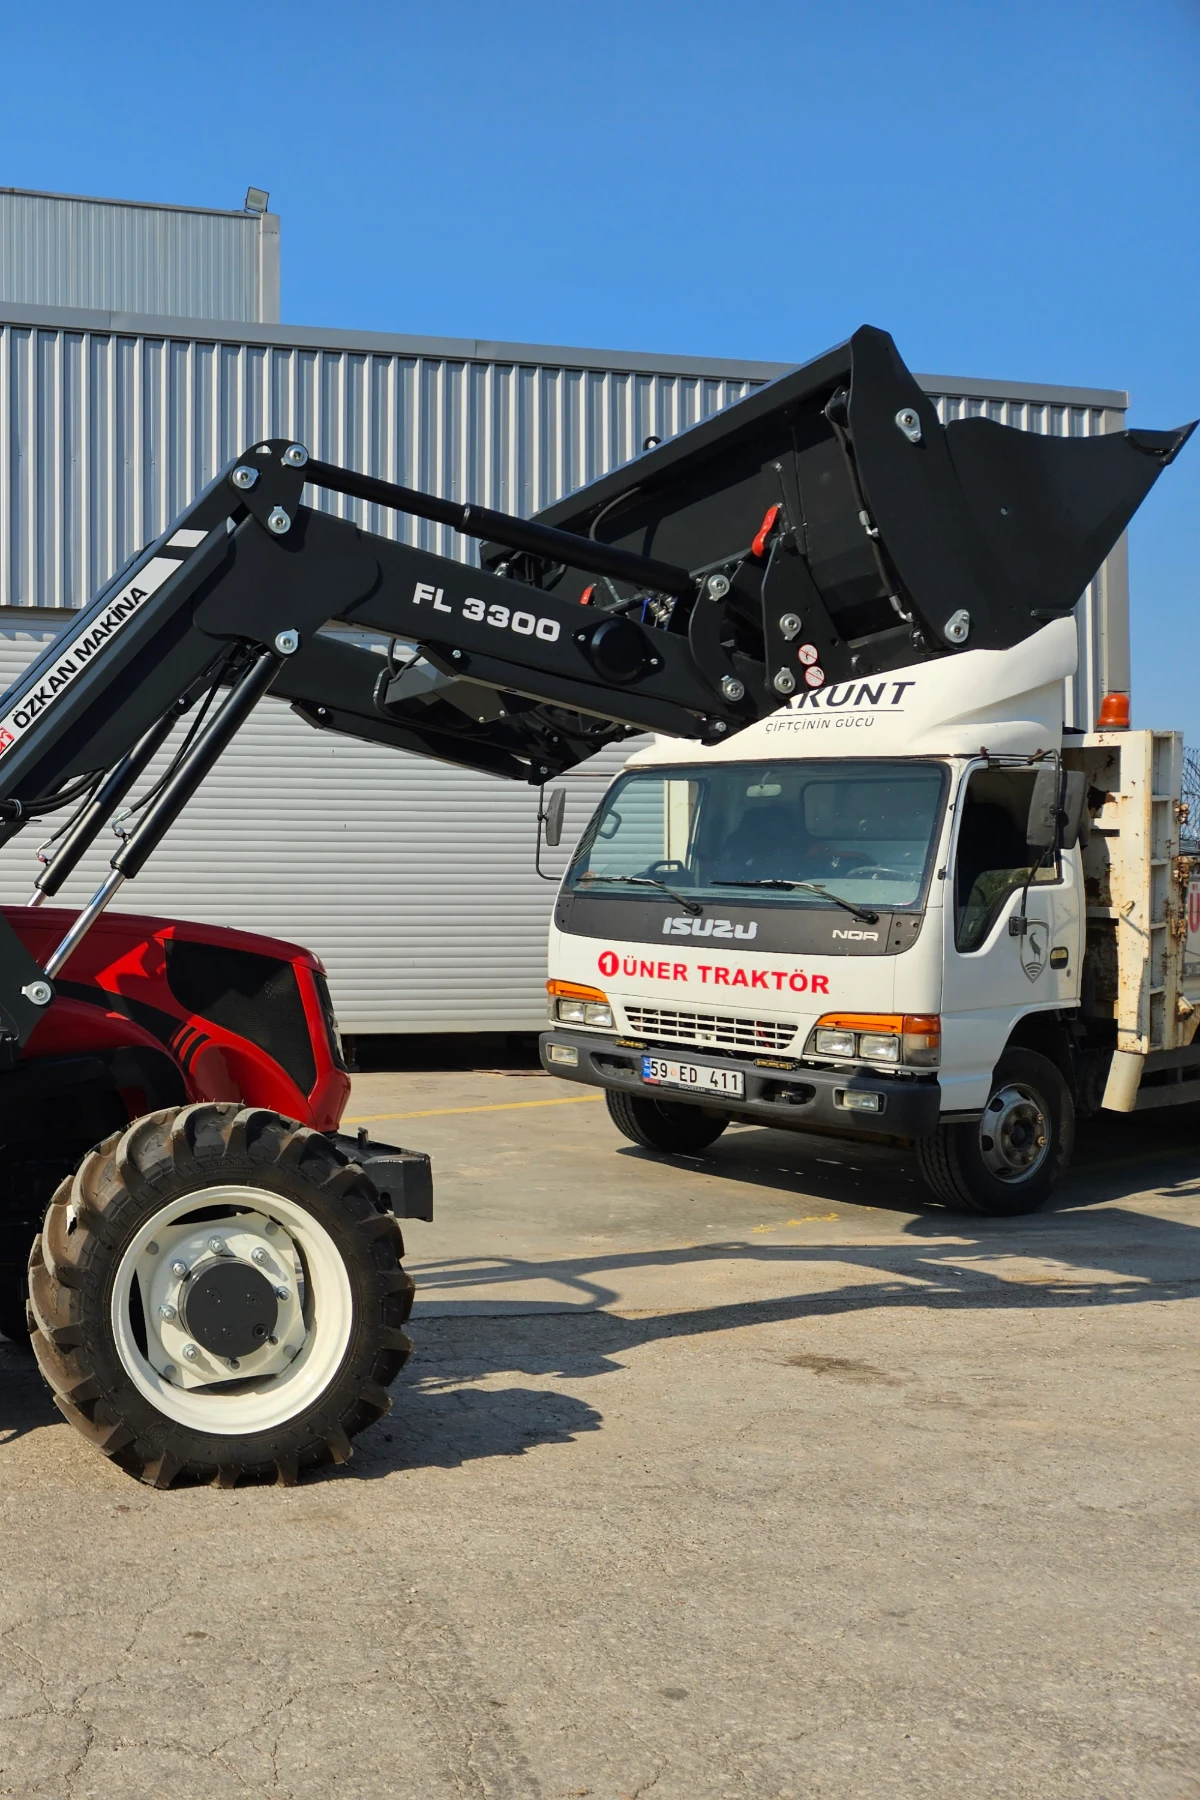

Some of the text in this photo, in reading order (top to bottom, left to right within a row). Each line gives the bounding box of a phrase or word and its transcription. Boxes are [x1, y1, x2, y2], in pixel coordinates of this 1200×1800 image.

[412, 582, 561, 642] FL 3300
[12, 659, 79, 729] ÖZKAN
[73, 587, 149, 662] MAKİNA
[784, 681, 916, 709] KUNT
[765, 715, 875, 734] ÇİFTÇİNİN GÜCÜ
[662, 917, 758, 940] ISUZU
[832, 929, 879, 942] NQR
[622, 954, 689, 982] ÜNER
[697, 965, 830, 995] TRAKTÖR
[650, 1061, 738, 1091] 59 ED 411
